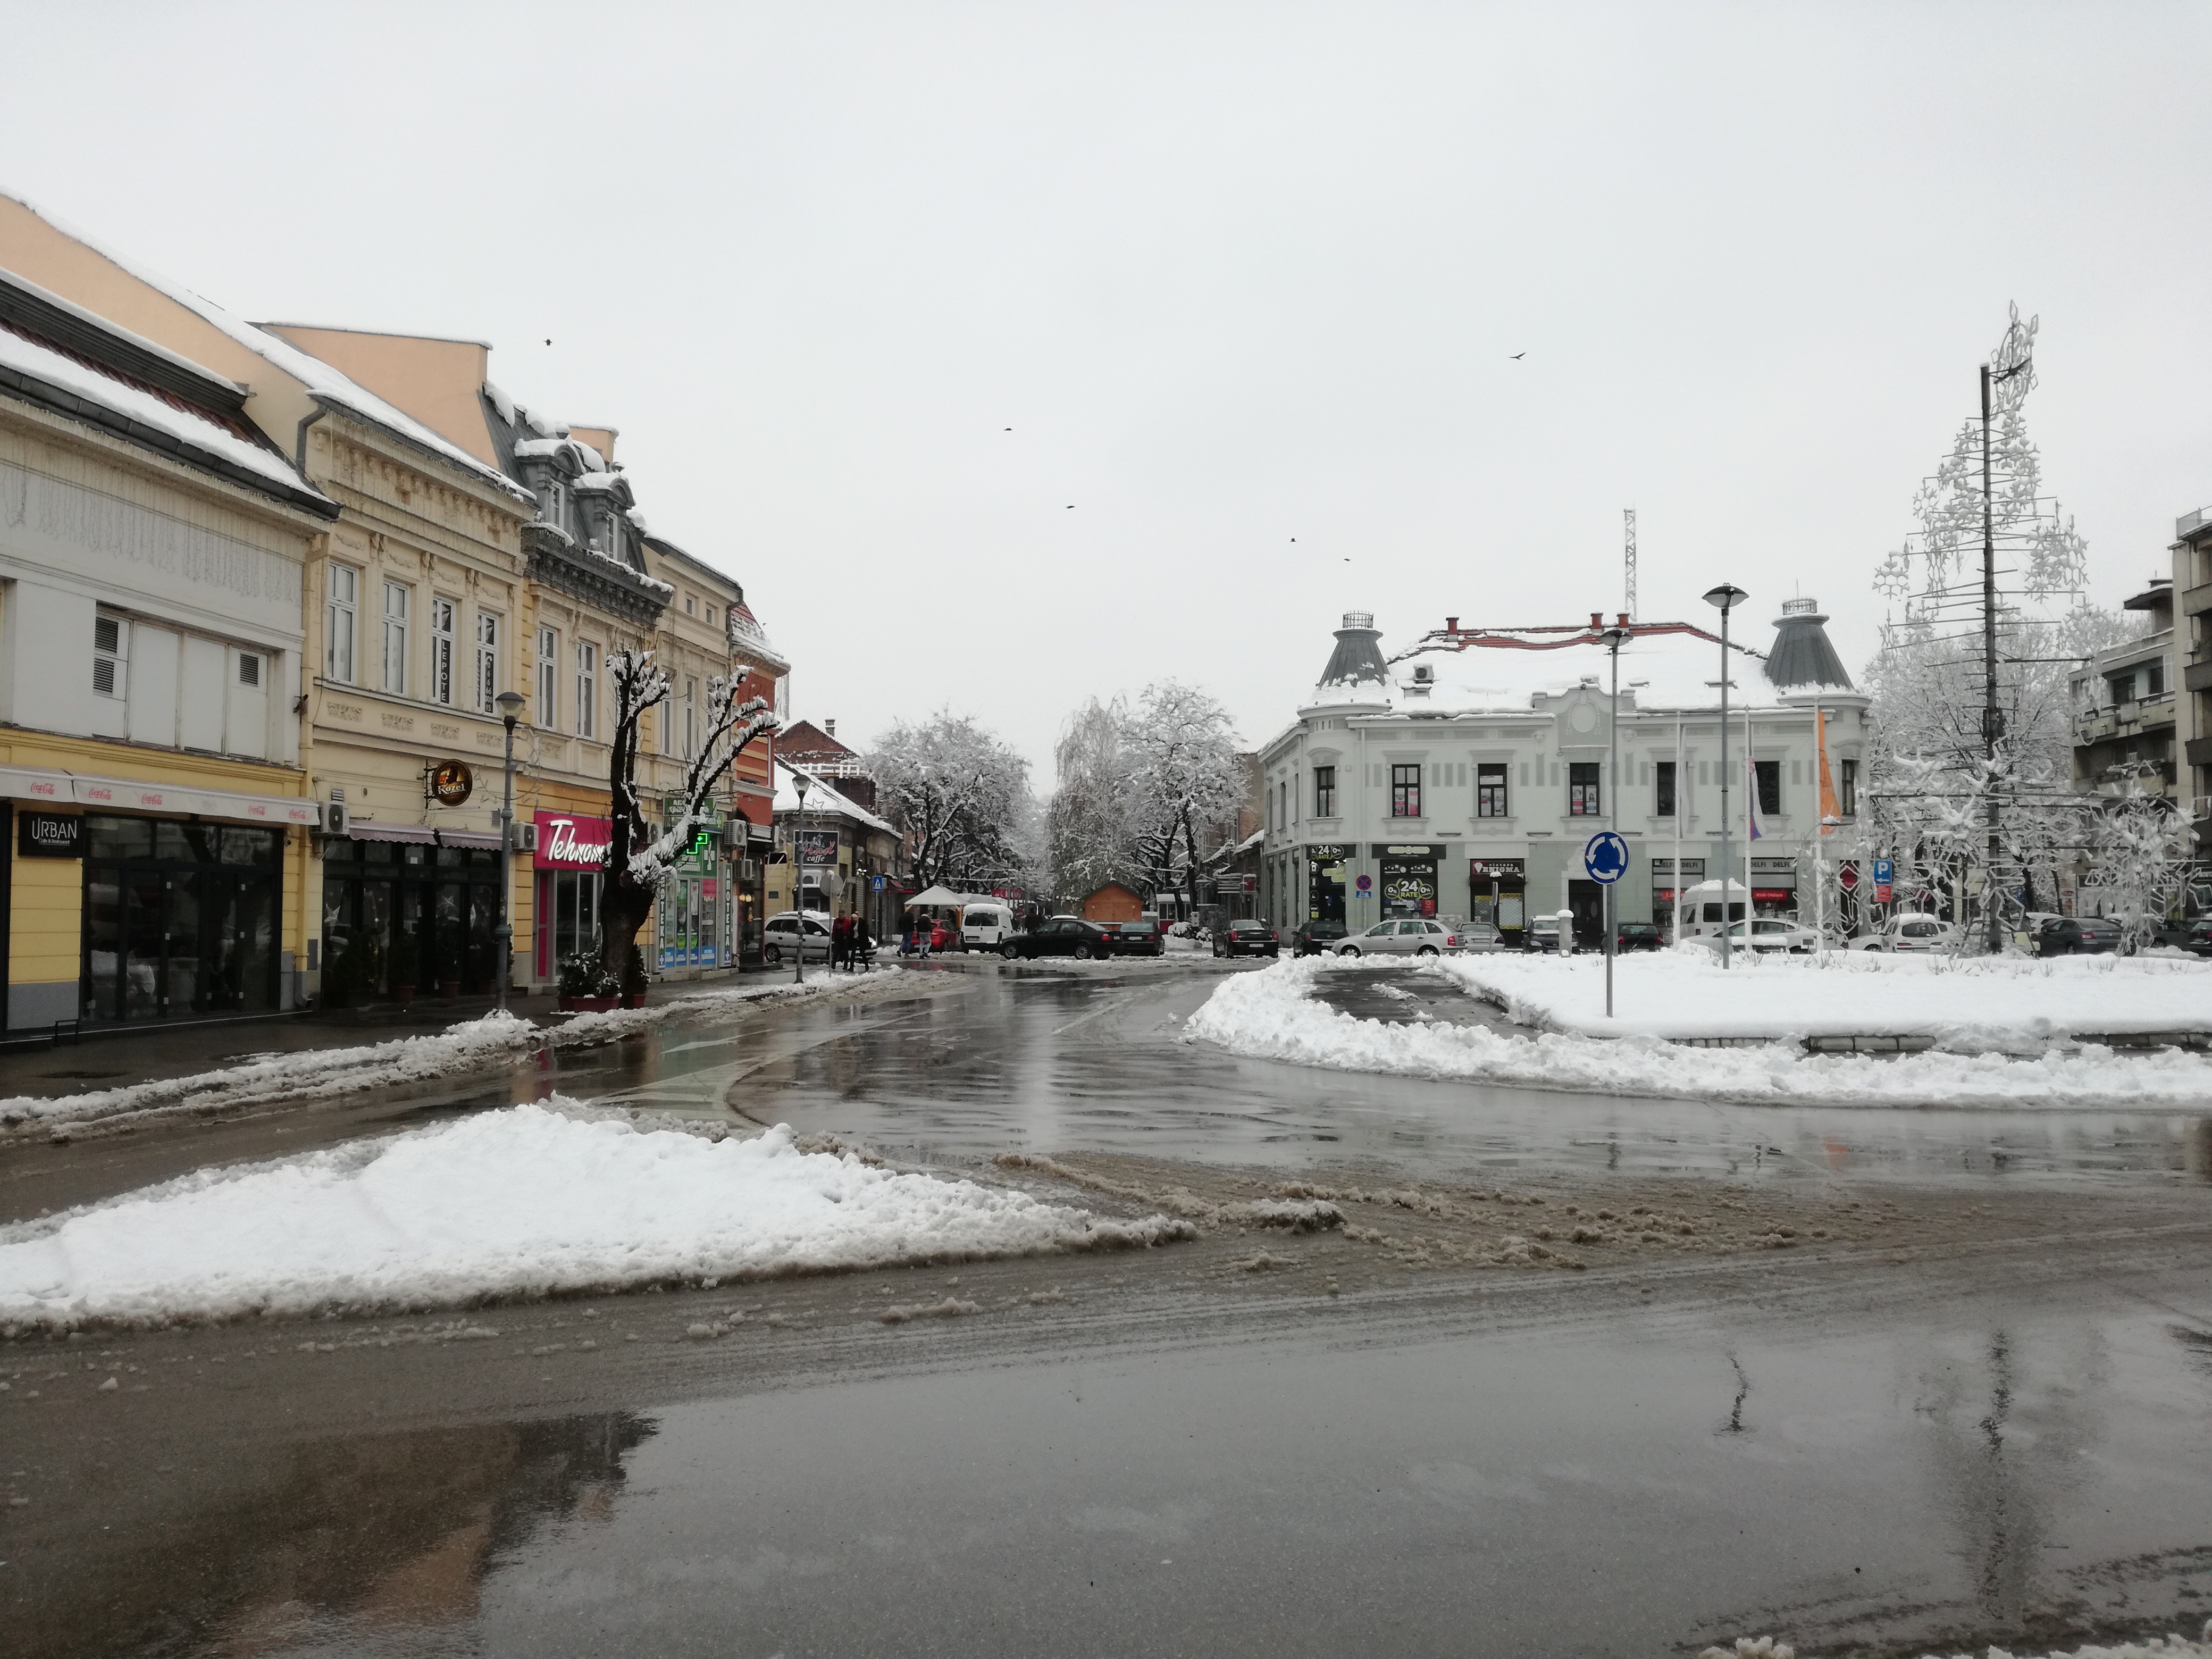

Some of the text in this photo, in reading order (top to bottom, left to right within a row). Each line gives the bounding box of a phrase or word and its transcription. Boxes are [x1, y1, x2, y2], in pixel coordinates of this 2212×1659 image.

[438, 783, 465, 794] Kozel
[32, 817, 77, 839] URBAN
[1319, 845, 1329, 854] 24
[807, 854, 825, 863] caffe
[1878, 862, 1888, 875] P
[1401, 881, 1418, 892] 24
